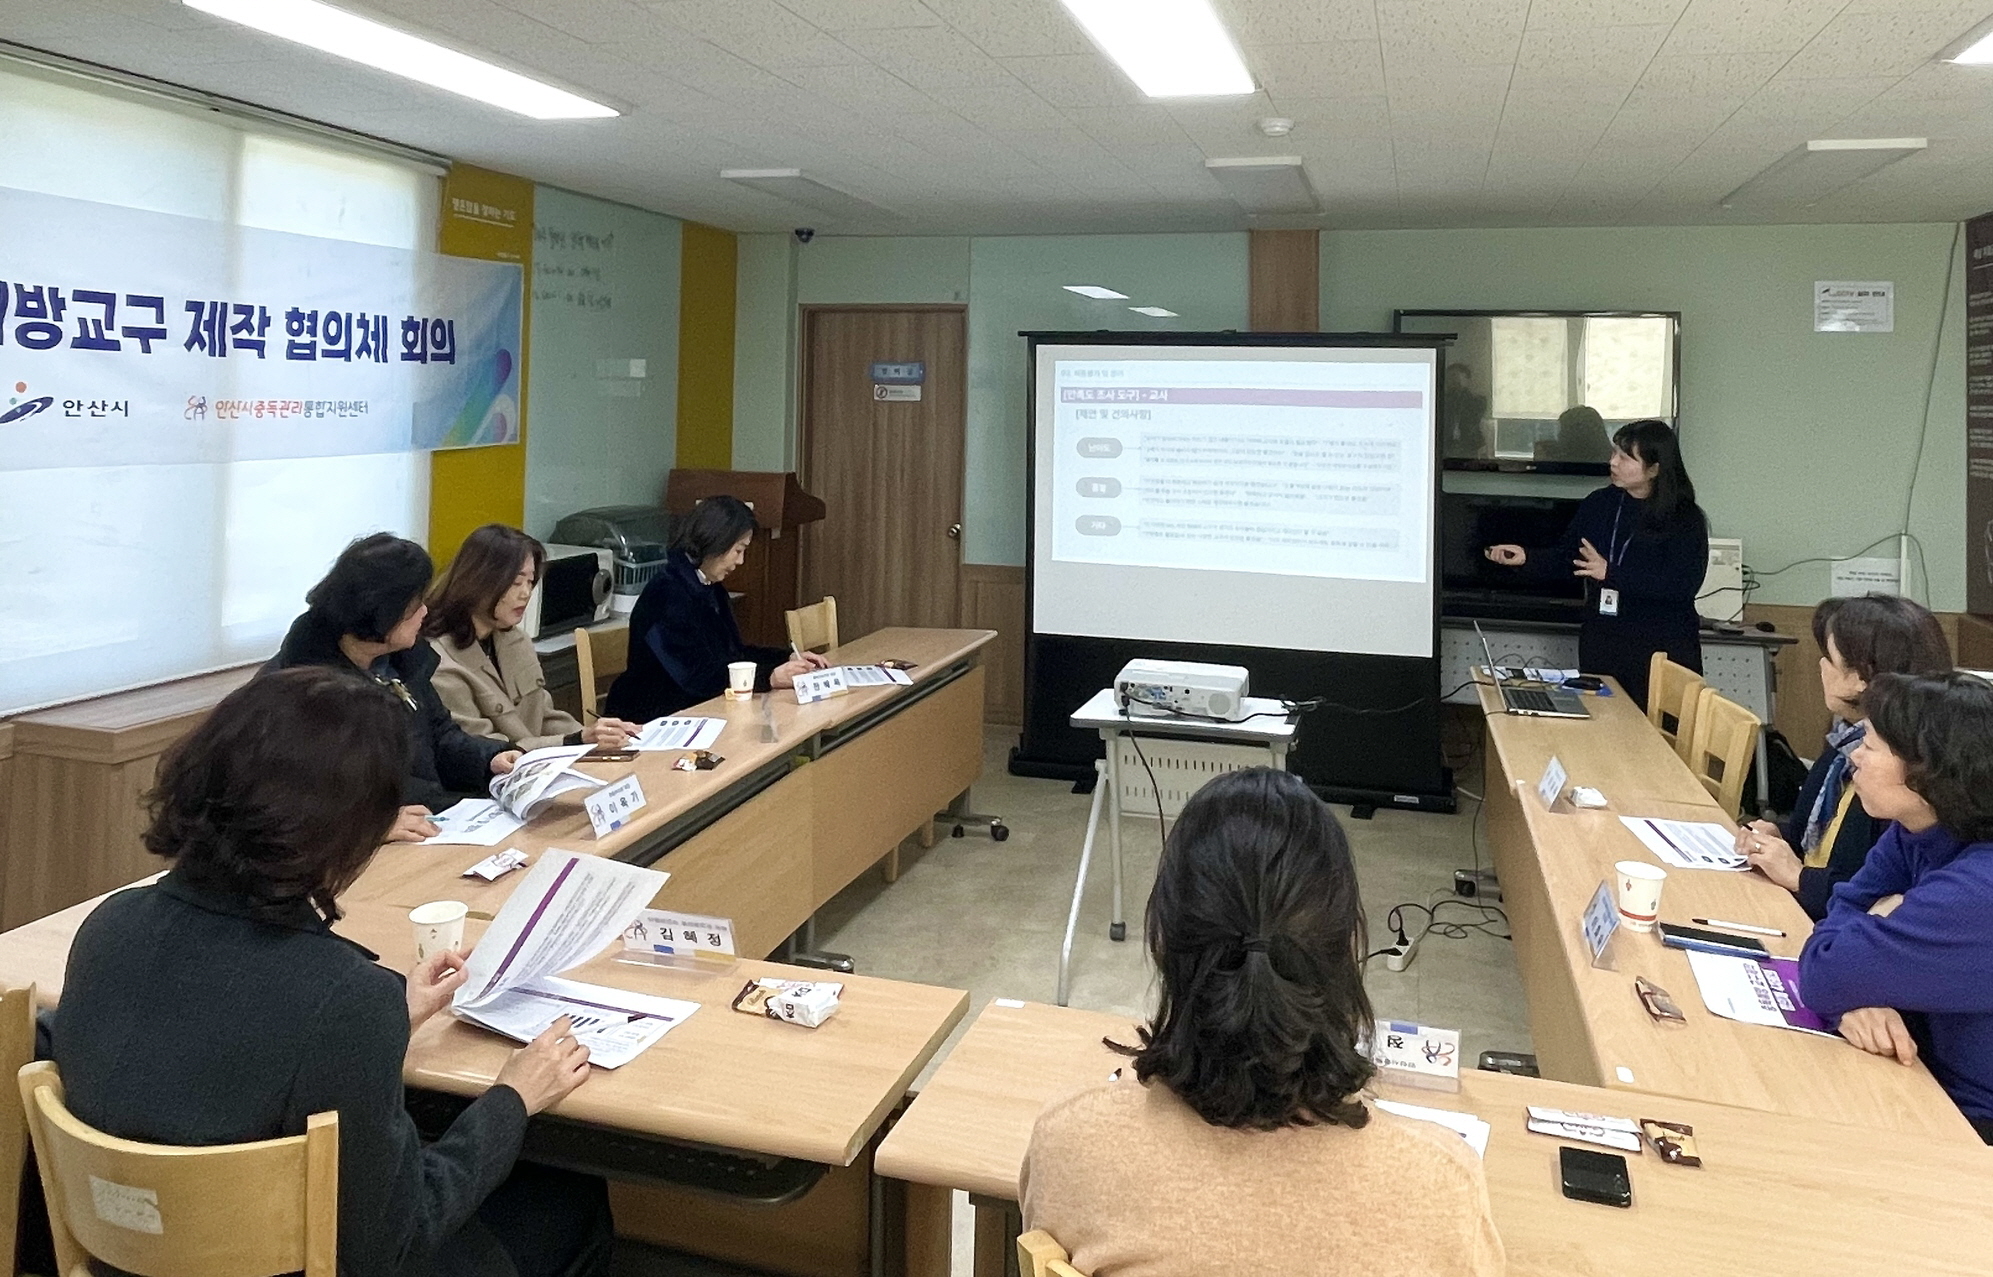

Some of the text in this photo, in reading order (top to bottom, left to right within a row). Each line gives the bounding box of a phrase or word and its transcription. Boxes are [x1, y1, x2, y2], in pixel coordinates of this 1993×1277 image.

[0, 280, 456, 365] 방교구 제작 협의체 회의
[63, 399, 129, 418] 안산시
[215, 400, 369, 420] 안산시중독관리통합지원센터
